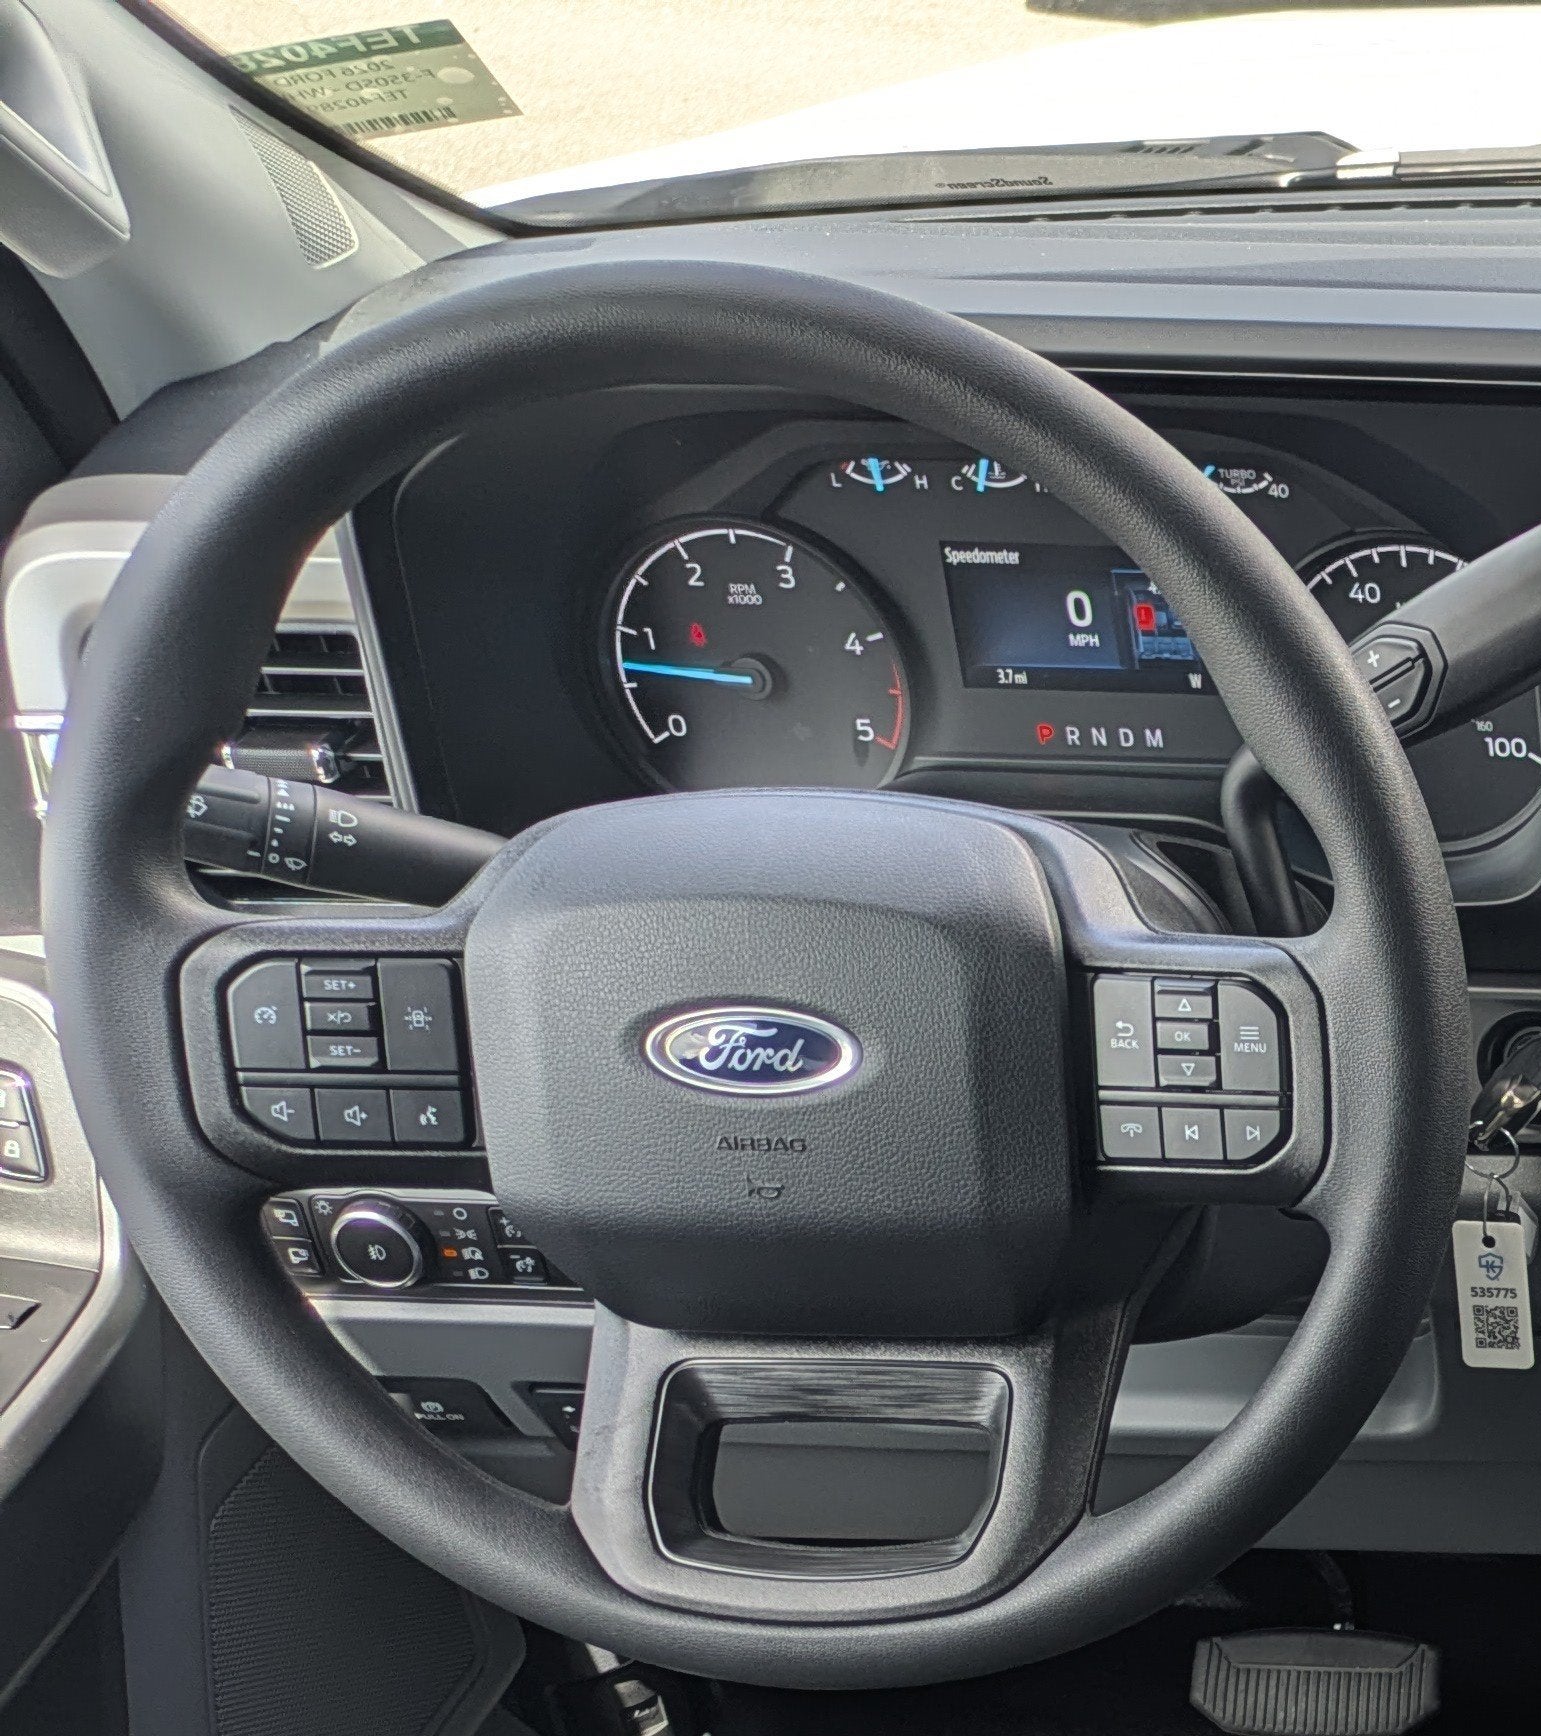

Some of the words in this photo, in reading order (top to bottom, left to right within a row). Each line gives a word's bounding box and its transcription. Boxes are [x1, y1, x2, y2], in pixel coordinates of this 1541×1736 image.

[830, 472, 842, 488] L
[914, 474, 929, 490] H
[951, 475, 964, 491] C
[1218, 468, 1256, 481] TURBO
[1268, 483, 1290, 499] 40
[944, 547, 1020, 566] Speedometer
[685, 563, 705, 587] 2
[776, 564, 796, 589] 3
[728, 583, 757, 595] RPM
[1349, 582, 1381, 604] 40
[1066, 589, 1094, 628] 0
[642, 627, 656, 650] 1
[844, 632, 864, 656] 4
[1068, 633, 1100, 648] MPH
[996, 668, 1014, 684] 3.7
[667, 714, 688, 737] 0
[855, 718, 875, 742] 5
[1036, 722, 1055, 745] P
[1065, 725, 1081, 746] R
[1092, 726, 1108, 747] N
[1119, 727, 1135, 748] D
[1145, 728, 1164, 748] M
[1484, 736, 1527, 758] 100
[323, 979, 356, 991] SET+
[1110, 1037, 1140, 1050] BACK
[1174, 1030, 1191, 1042] OK
[699, 1024, 804, 1074] Ford
[1233, 1041, 1268, 1054] MENU
[717, 1134, 807, 1153] AIRBAG
[1470, 1286, 1518, 1299] 535775
